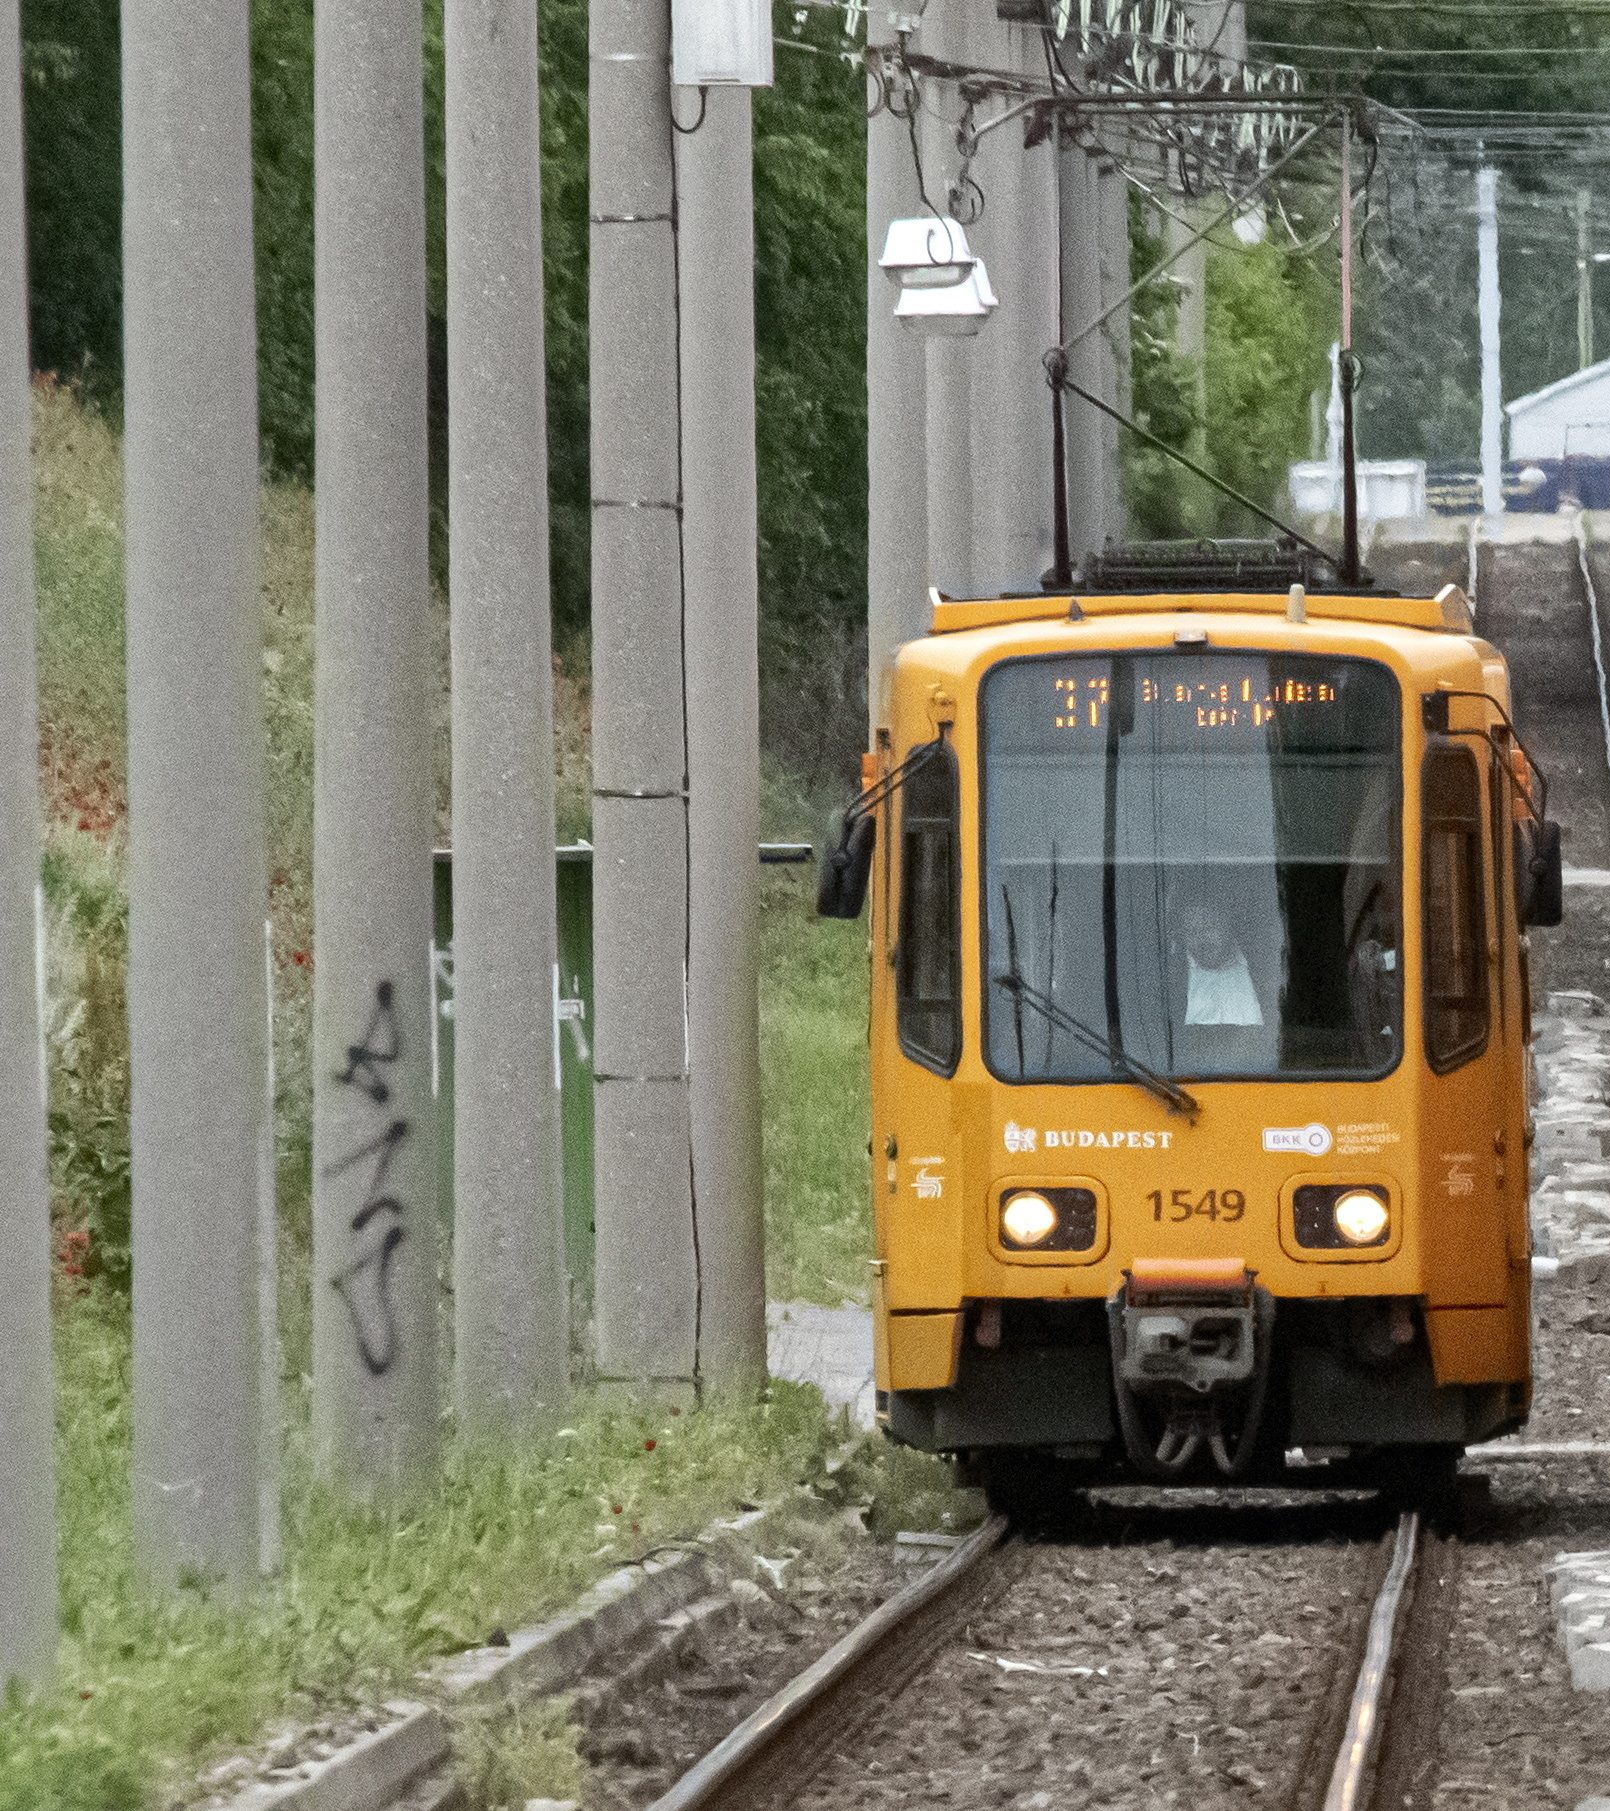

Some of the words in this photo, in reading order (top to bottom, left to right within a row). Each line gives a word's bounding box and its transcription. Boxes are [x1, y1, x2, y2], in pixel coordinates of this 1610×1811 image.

[1055, 678, 1109, 728] 37
[1044, 1130, 1173, 1149] BUDAPEST
[1272, 1134, 1302, 1146] BKK
[1145, 1188, 1246, 1222] 1549
